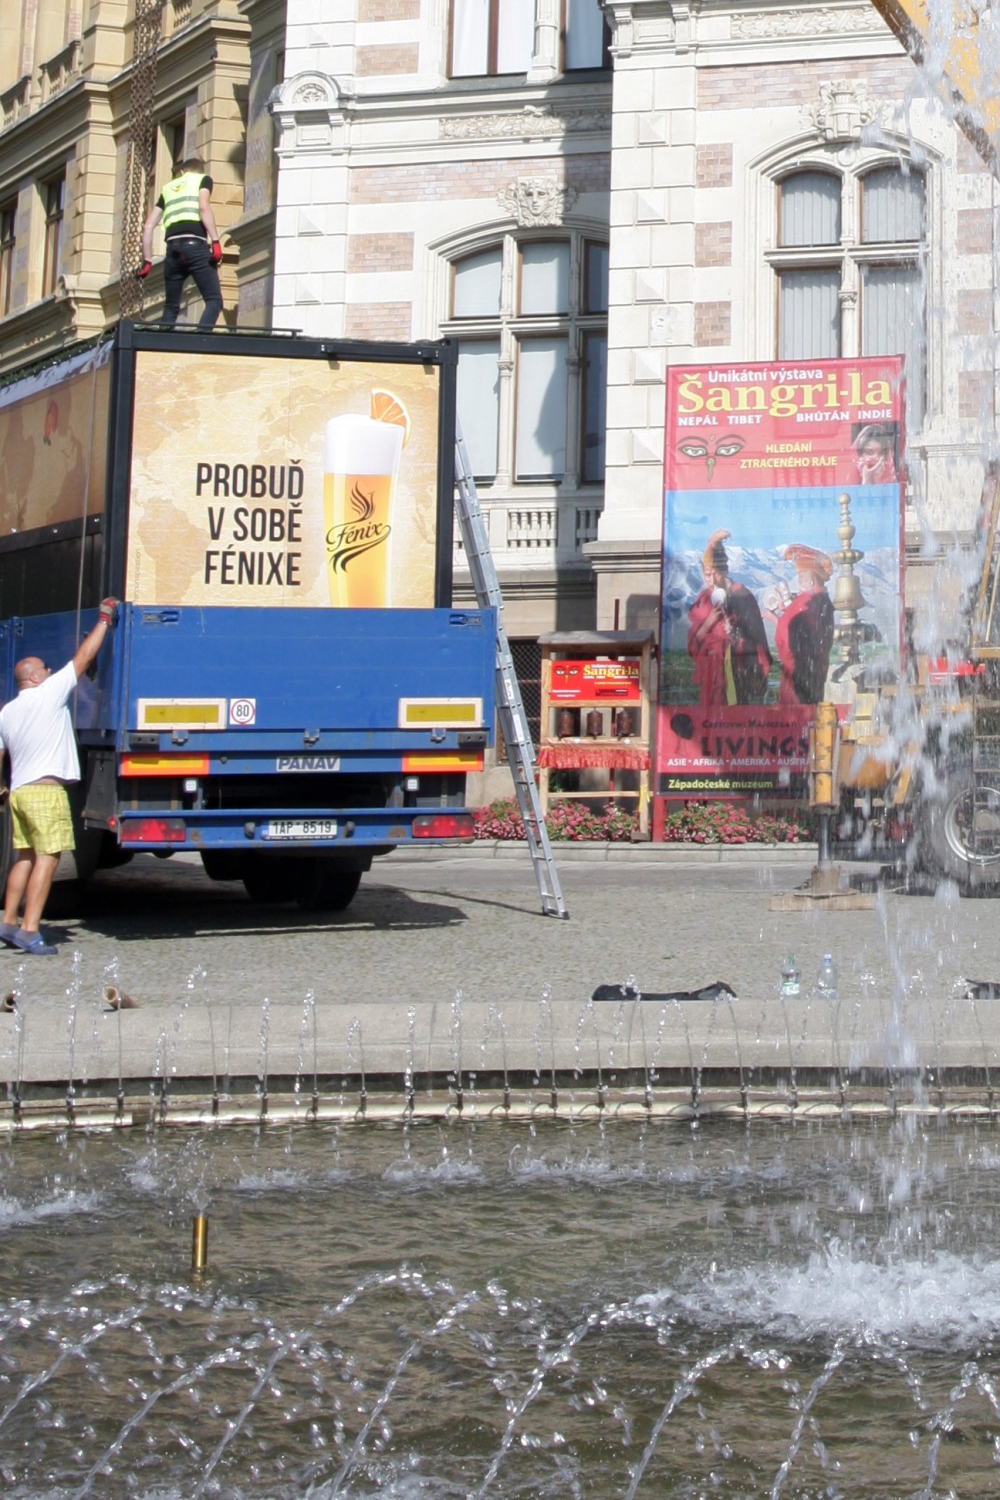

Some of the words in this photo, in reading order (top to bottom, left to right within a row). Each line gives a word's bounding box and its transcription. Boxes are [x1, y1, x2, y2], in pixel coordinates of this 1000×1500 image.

[708, 368, 767, 384] Unikátní
[770, 367, 823, 384] výstava
[678, 372, 893, 418] Šangri-la
[678, 413, 718, 427] NEPÁL
[727, 414, 762, 425] TIBET
[796, 409, 850, 423] BHÚTÁN
[857, 409, 892, 420] INDIE
[765, 441, 812, 454] HLEDÁNÍ
[740, 457, 809, 469] ZTRACENÉHO
[811, 455, 838, 468] RÁJE
[195, 459, 304, 499] PROBUĎ
[208, 506, 225, 541] V
[233, 502, 303, 543] SOBĚ
[331, 520, 388, 550] Fénix
[204, 544, 302, 586] FÉNIXE
[583, 664, 639, 677] Šangri-la
[236, 704, 249, 717] 80
[702, 736, 810, 757] LIVINGS
[278, 757, 338, 770] PANAV
[667, 758, 687, 766] ASIE
[693, 758, 725, 766] AFRIKA
[730, 758, 771, 766] AMERIKA
[668, 779, 731, 791] Západočeské
[732, 780, 773, 789] muzeum
[273, 821, 293, 834] 1AP
[303, 820, 331, 834] 8519
